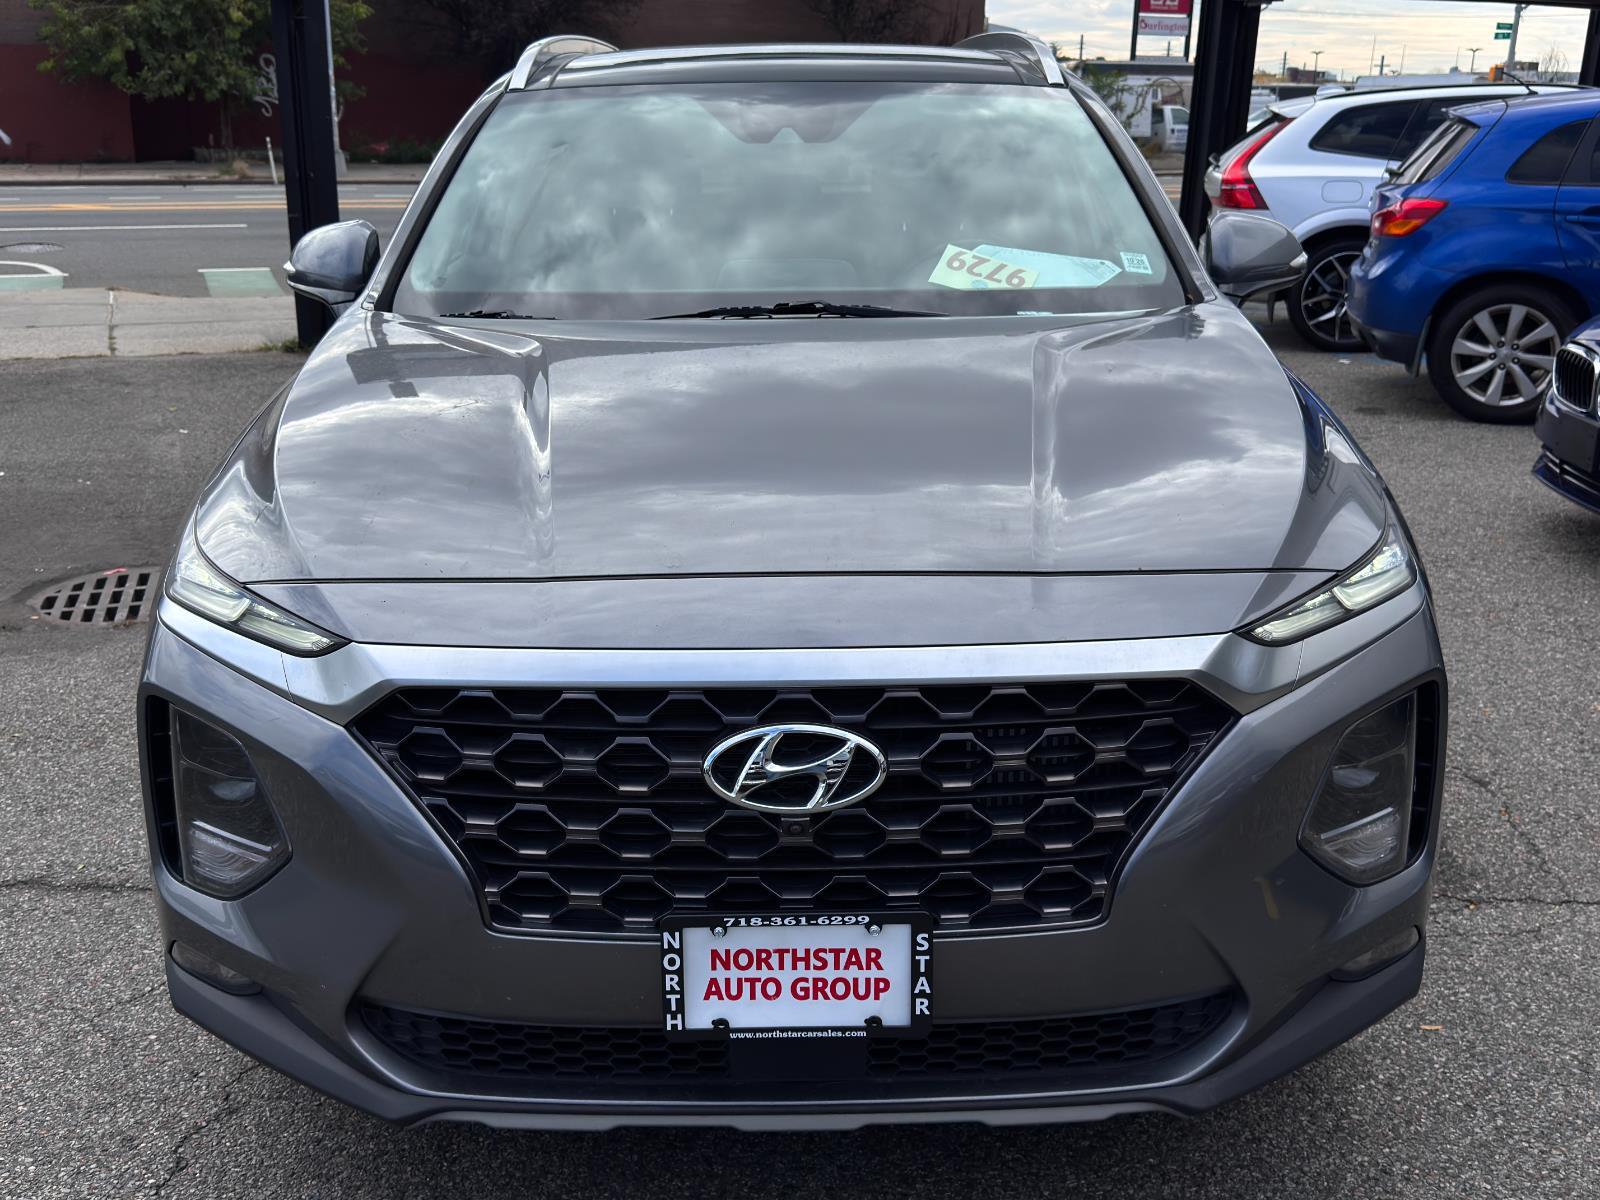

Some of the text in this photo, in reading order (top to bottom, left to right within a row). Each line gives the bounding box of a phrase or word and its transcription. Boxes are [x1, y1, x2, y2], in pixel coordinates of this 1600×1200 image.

[1139, 18, 1187, 32] Burlington
[946, 250, 1026, 288] 9729
[723, 915, 870, 927] 718-361-6299
[710, 948, 884, 971] NORTHSTAR
[662, 931, 683, 1031] NORTH
[914, 933, 932, 1015] STAR
[703, 977, 891, 1001] AUTO GROUP
[729, 1029, 867, 1039] www.northstarcarsales.com
